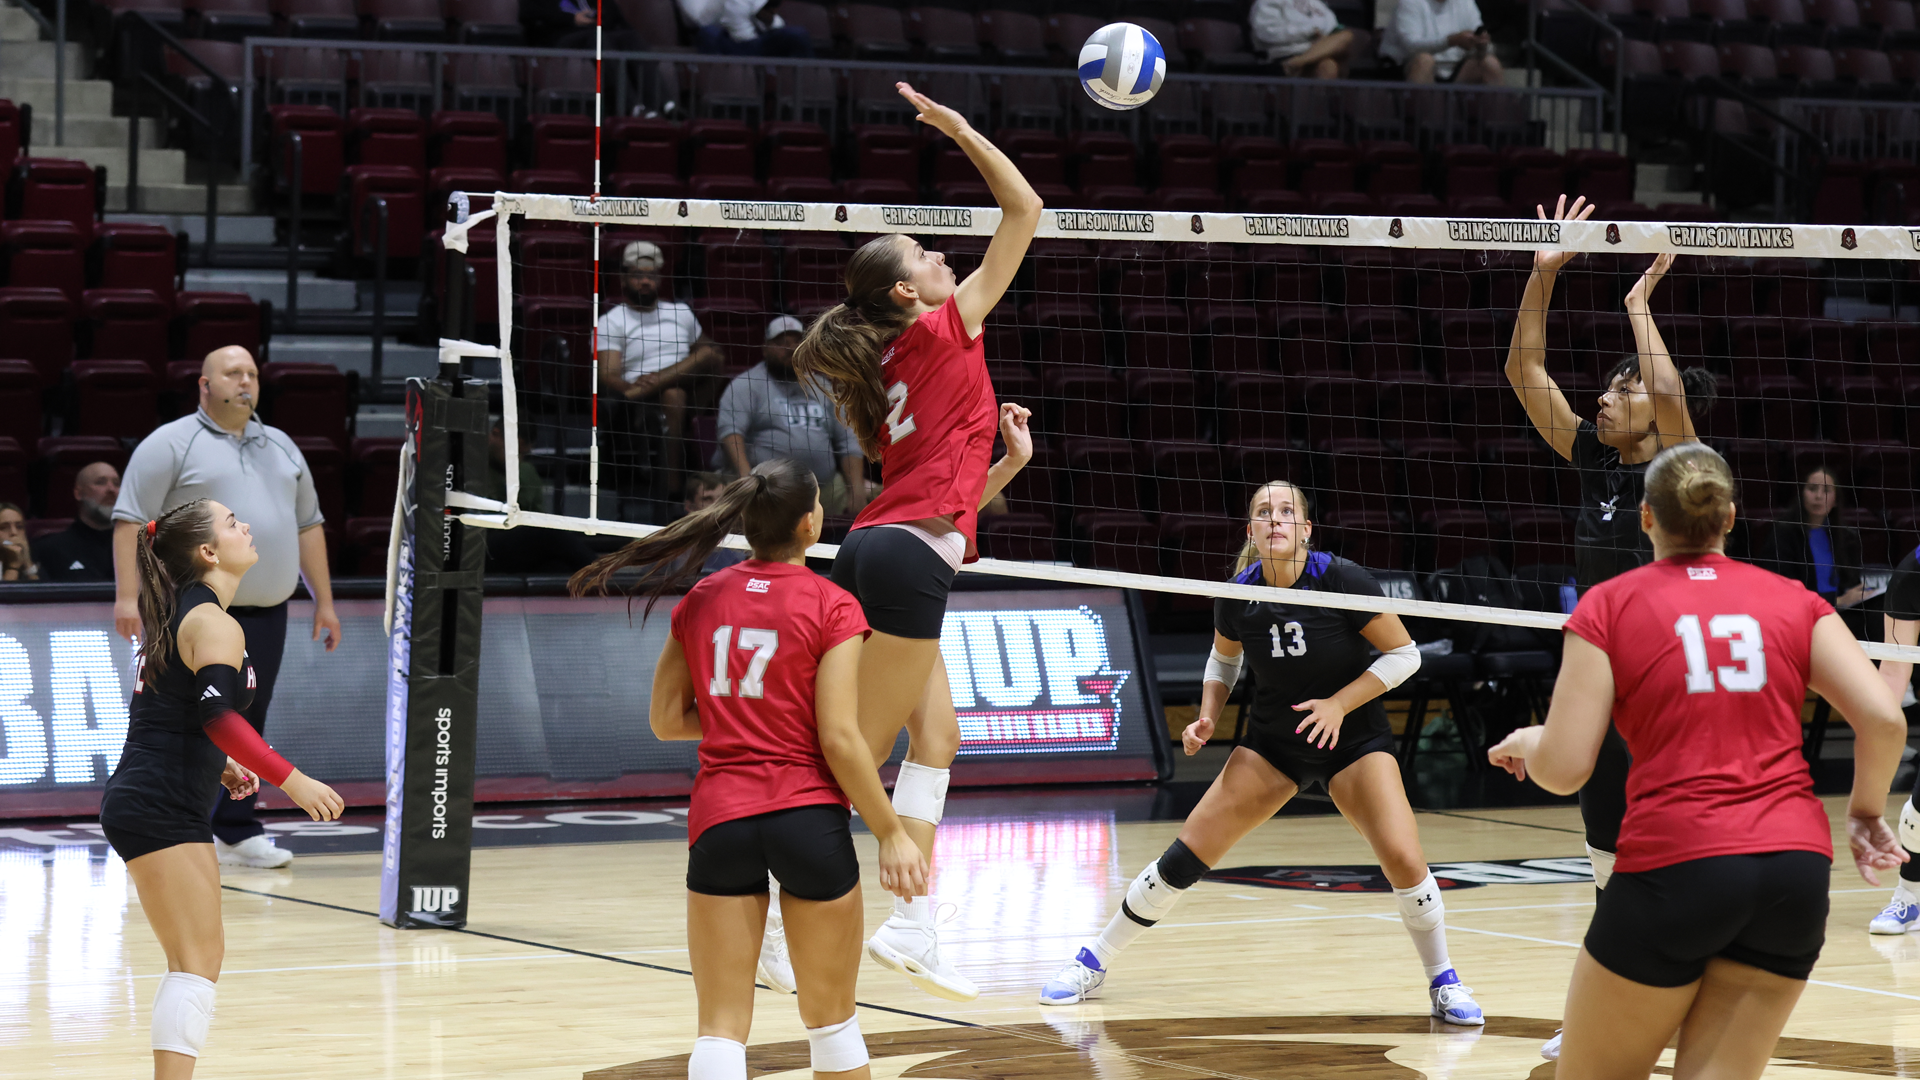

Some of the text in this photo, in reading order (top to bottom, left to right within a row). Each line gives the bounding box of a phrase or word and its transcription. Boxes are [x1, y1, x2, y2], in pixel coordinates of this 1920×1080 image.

[719, 202, 805, 222] CRIMSON HAWKS
[882, 206, 972, 227] CRIMSON HAWKS
[1057, 211, 1154, 232] CRIMSON HAWKS
[1243, 216, 1349, 238] CRIMSON HAWKS
[1447, 220, 1561, 243] CRIMSON HAWKS
[1667, 225, 1794, 249] CRIMSON HAWKS
[746, 579, 771, 591] PSAC
[1269, 621, 1307, 658] 13
[710, 625, 779, 699] 17
[940, 608, 1111, 708] IUP
[1674, 614, 1767, 694] 13
[431, 707, 452, 839] sports imports
[412, 886, 460, 912] IUP
